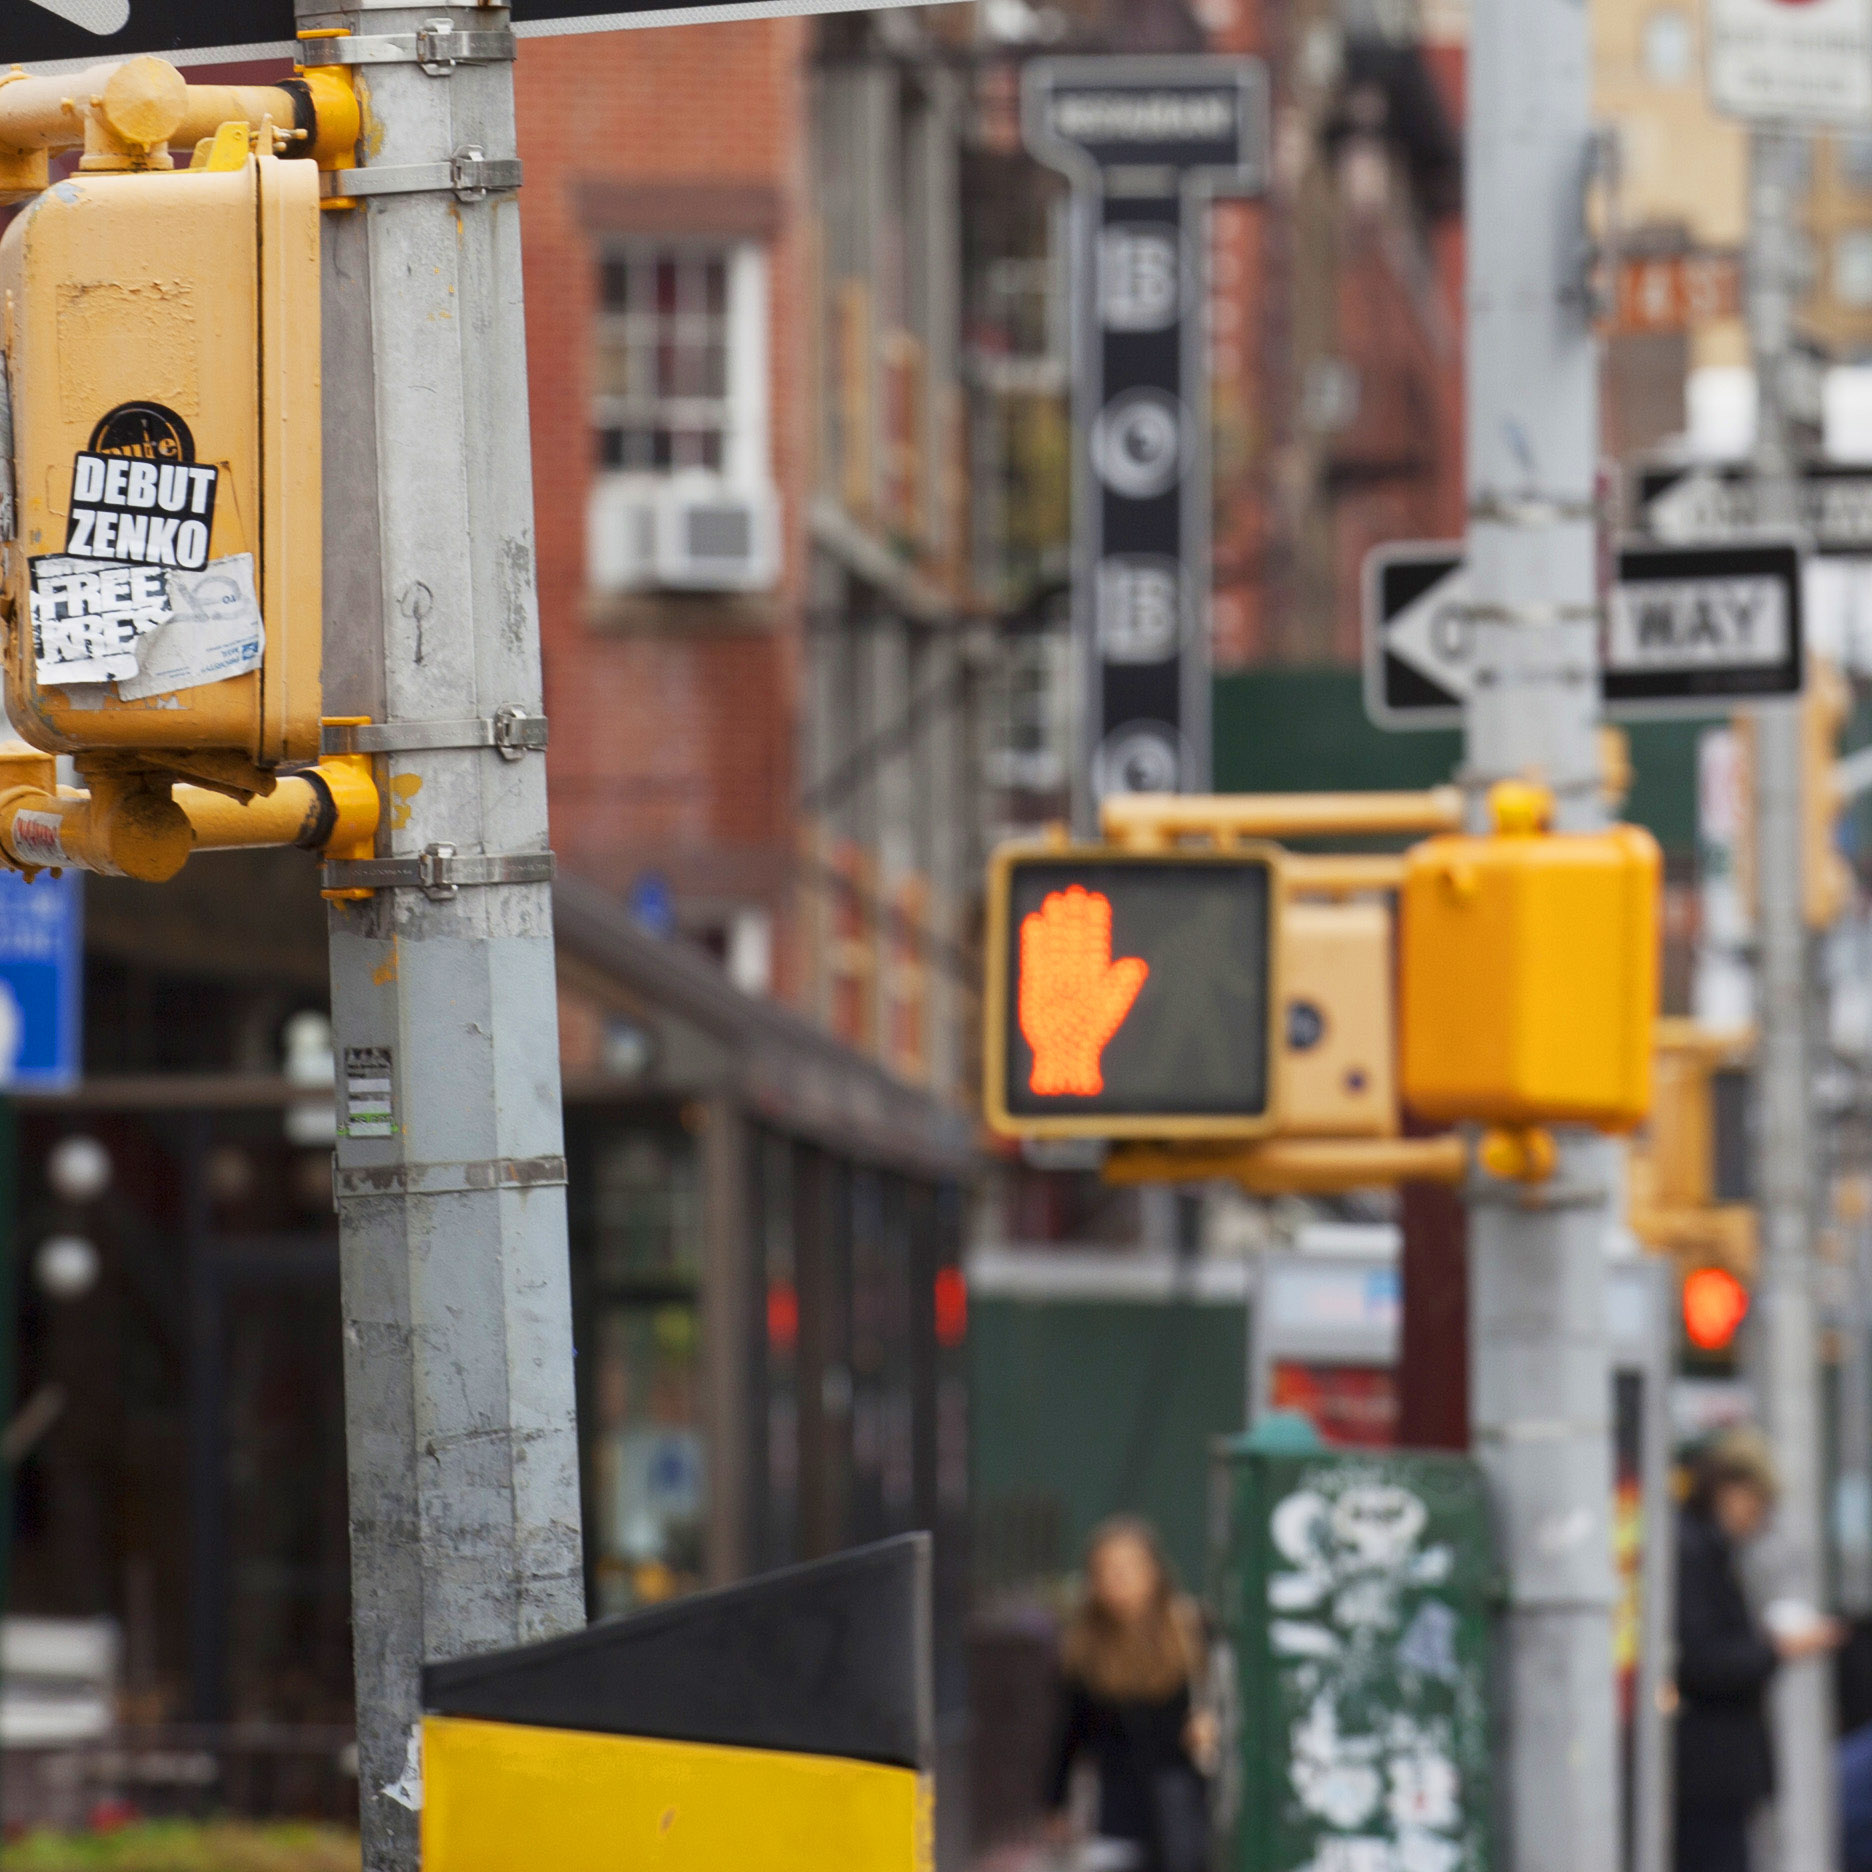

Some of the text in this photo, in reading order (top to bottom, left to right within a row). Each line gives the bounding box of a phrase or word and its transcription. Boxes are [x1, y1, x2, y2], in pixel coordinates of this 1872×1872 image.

[73, 455, 216, 514] DEBUT
[67, 508, 209, 568] ZENKO
[36, 567, 168, 618] FREE
[1636, 583, 1766, 650] WAY
